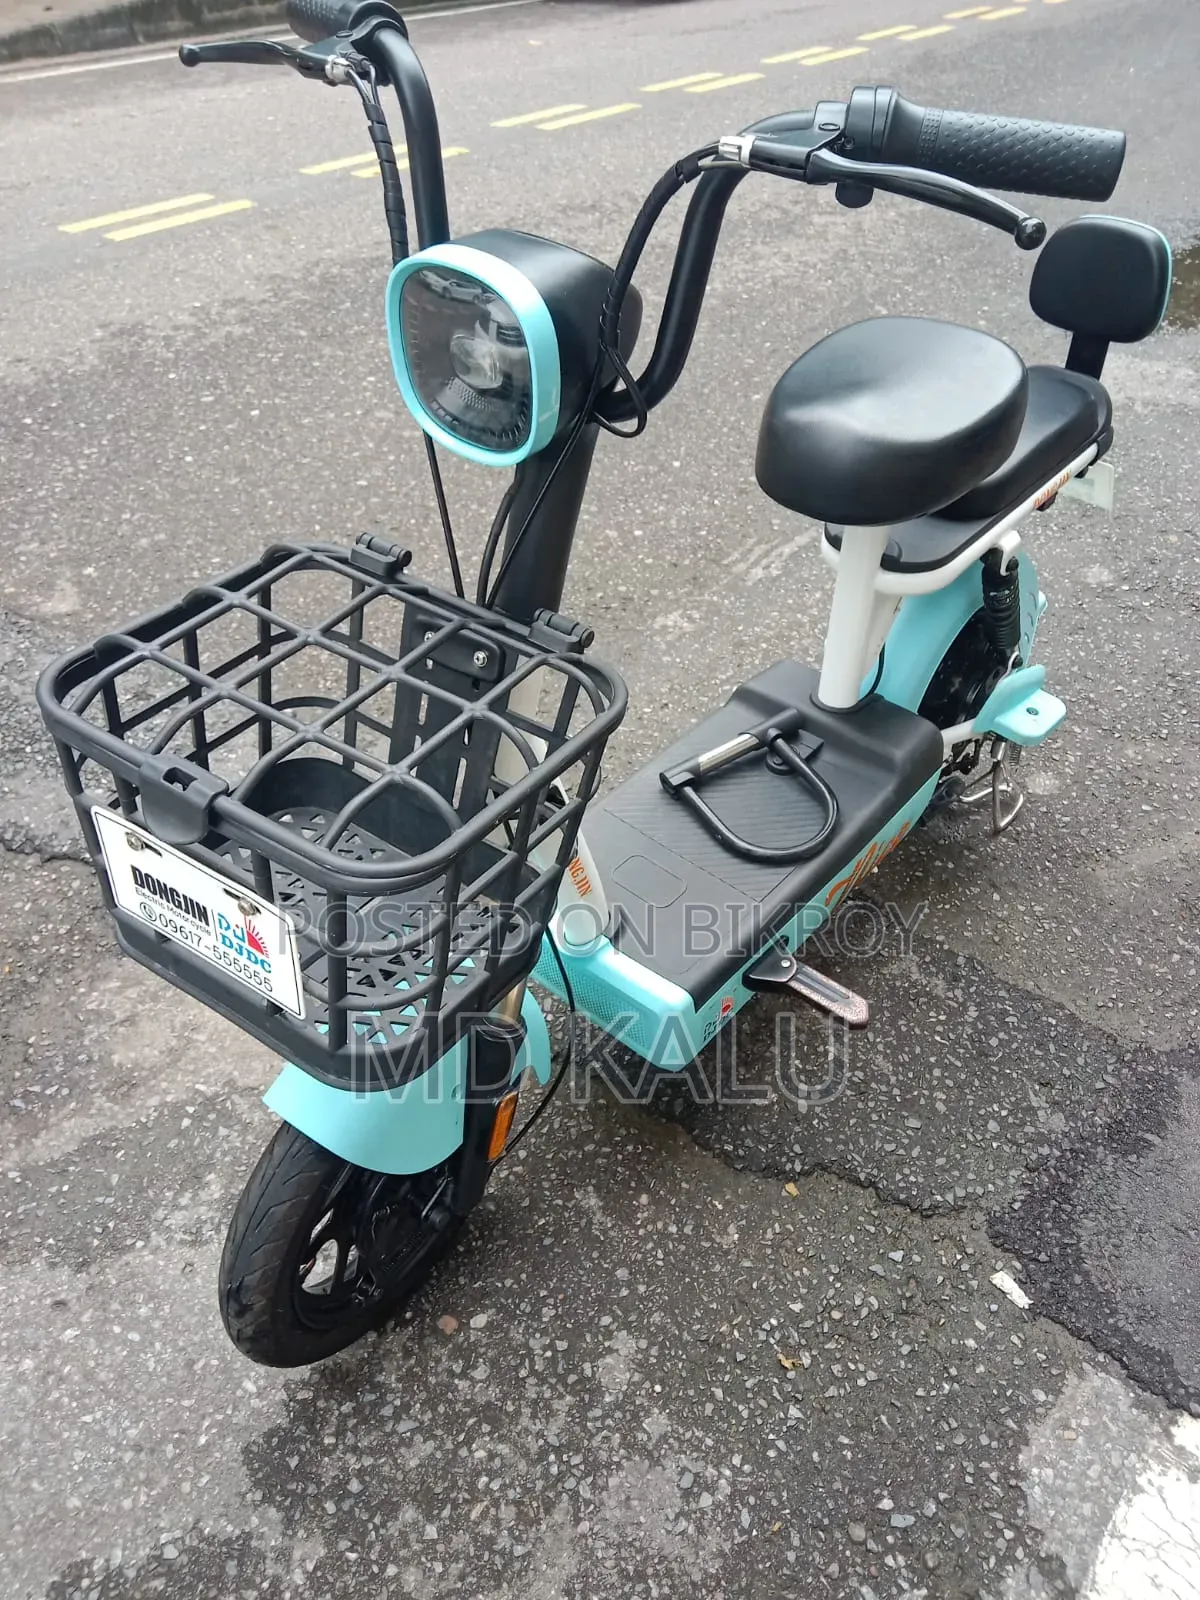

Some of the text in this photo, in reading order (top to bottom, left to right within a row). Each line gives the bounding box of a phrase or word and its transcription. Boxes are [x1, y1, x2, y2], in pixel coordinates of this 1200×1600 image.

[131, 865, 210, 927] DONGJIN
[568, 856, 592, 898] NGJIN
[158, 914, 273, 992] 09617-555555
[220, 933, 273, 974] DJDC
